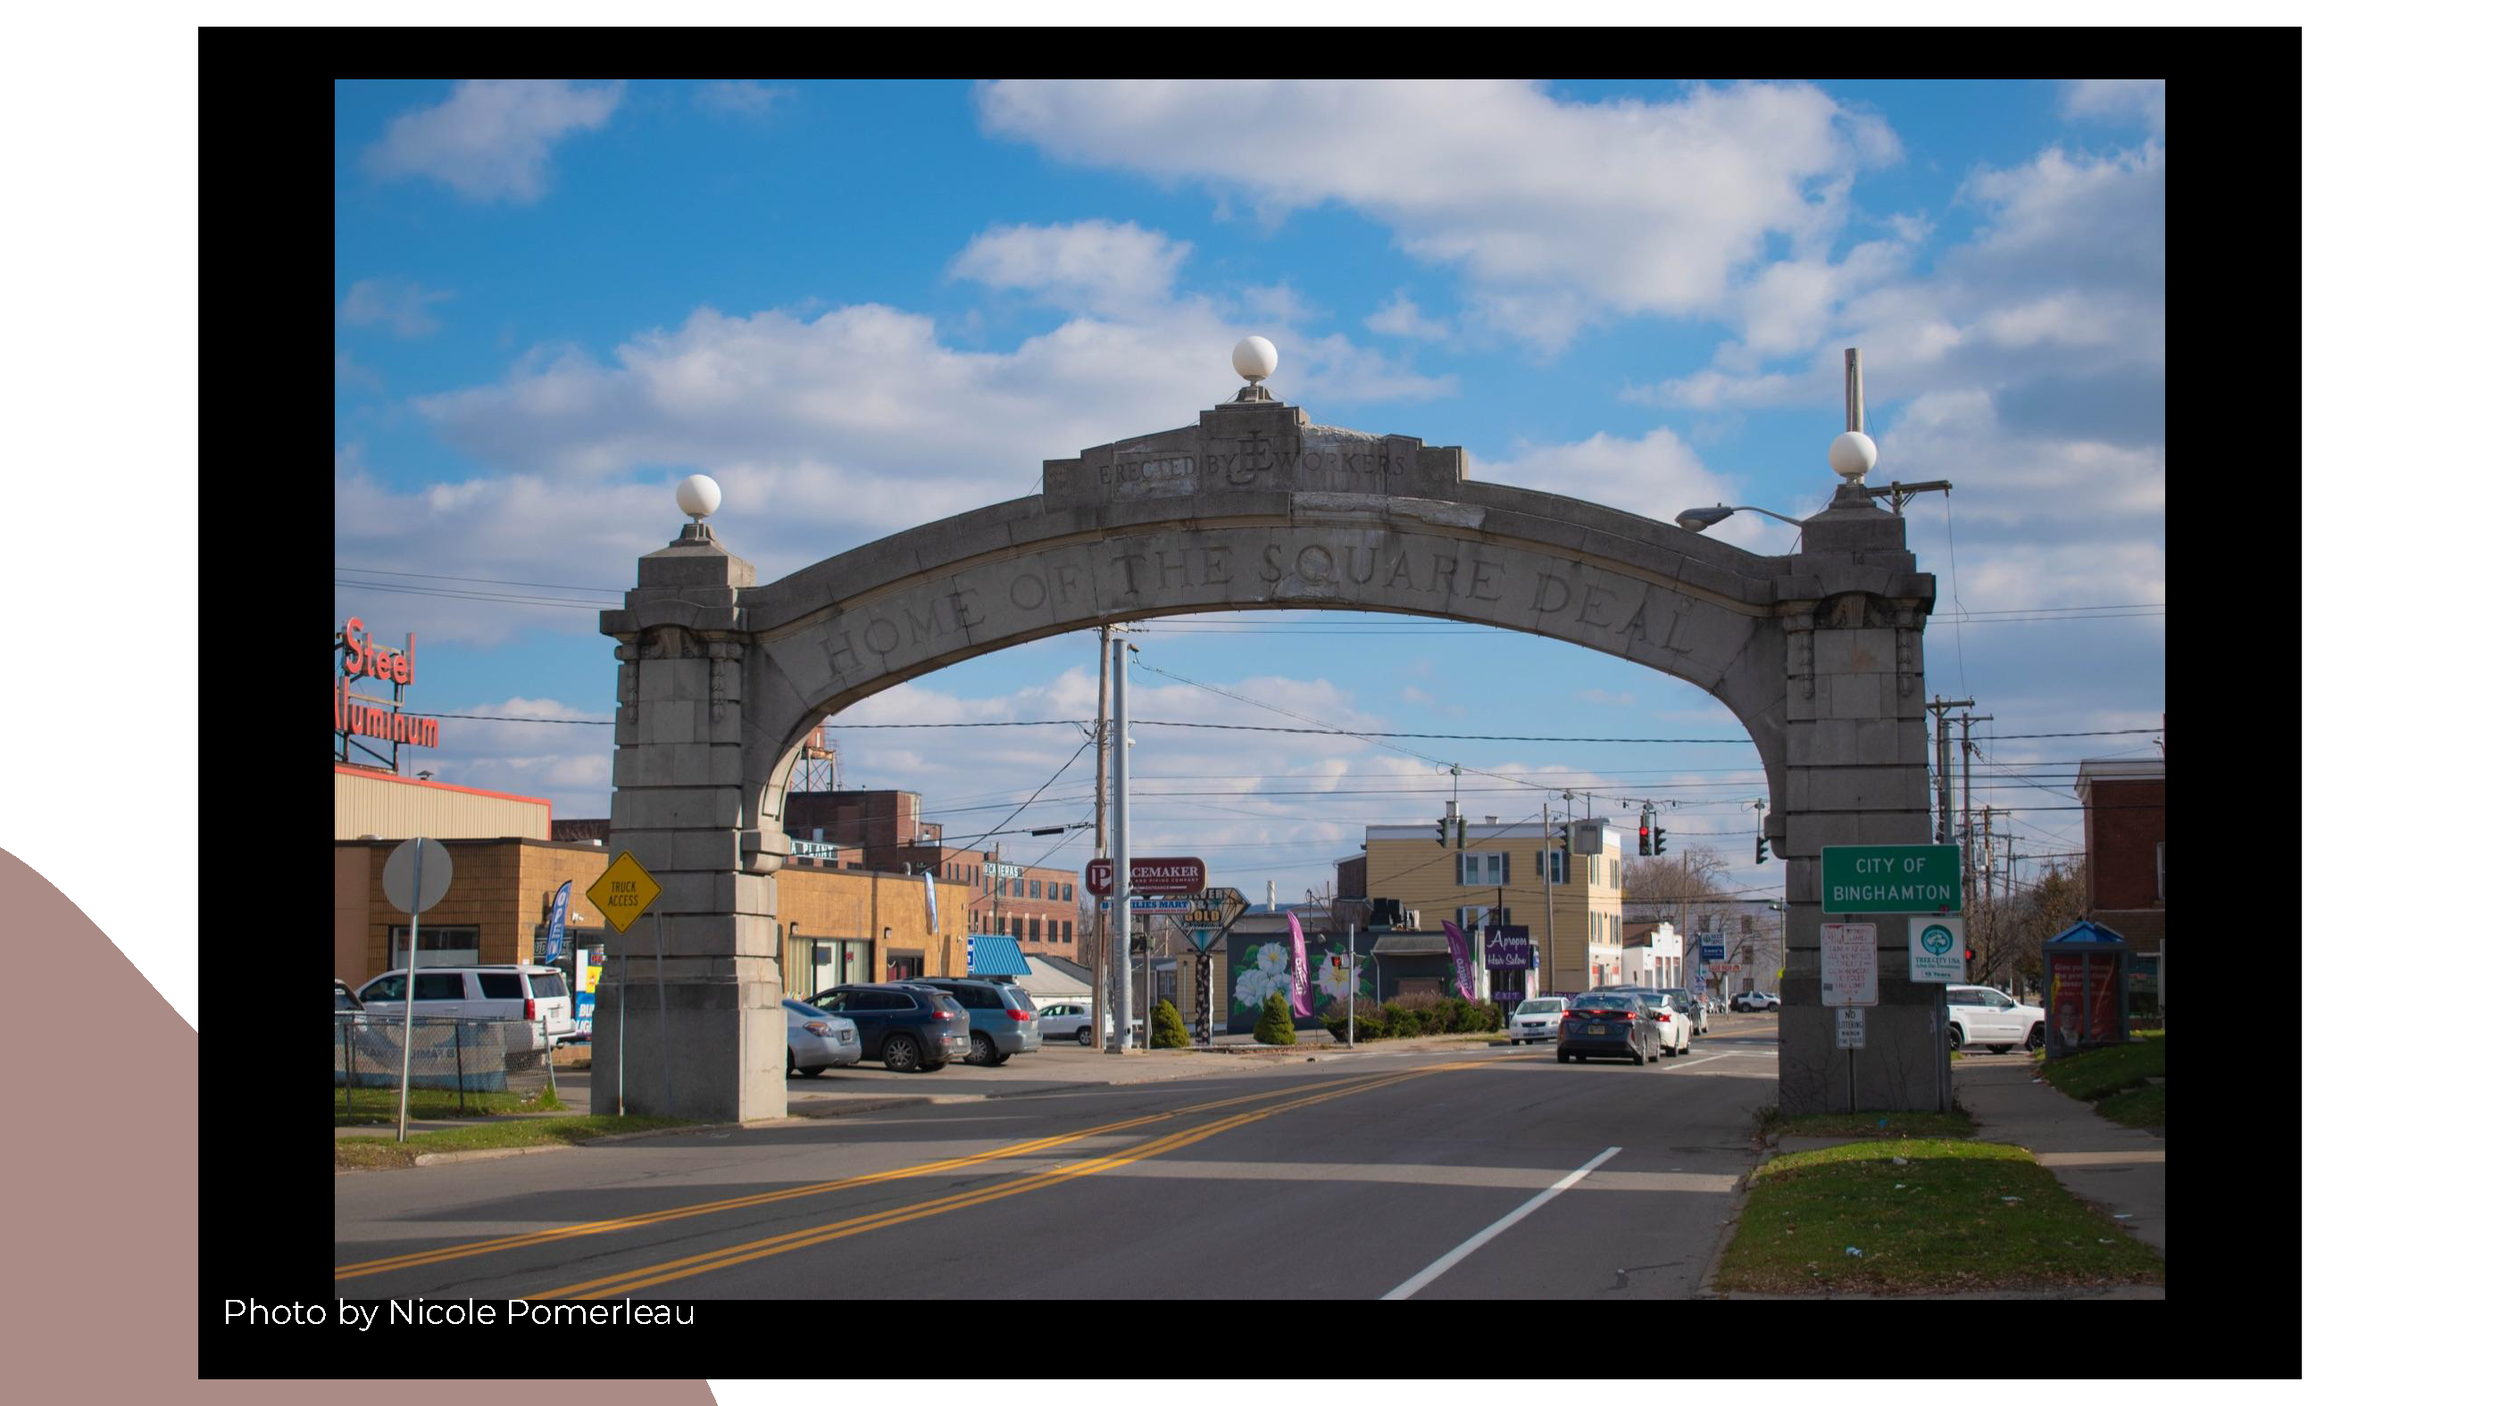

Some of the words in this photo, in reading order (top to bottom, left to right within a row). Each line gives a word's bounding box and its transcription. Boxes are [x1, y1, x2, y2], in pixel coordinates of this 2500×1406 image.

[1100, 455, 1195, 484] ERECTED
[1207, 452, 1237, 475] BY
[1272, 451, 1405, 476] WORKERS
[819, 587, 986, 678] HOME
[1009, 564, 1083, 611] OF
[1111, 545, 1235, 595] THE
[1258, 543, 1508, 600] SQUARE
[1528, 571, 1694, 655] DEAL
[345, 616, 416, 686] Steel
[803, 843, 834, 857] PLANT
[1130, 866, 1199, 877] CEMAKER
[1855, 857, 1895, 873] CITY
[1903, 857, 1927, 873] OF
[611, 881, 637, 893] TRUCK
[1833, 884, 1951, 900] BINGHAMTON
[608, 895, 639, 907] ACCESS
[1159, 901, 1188, 909] MART
[551, 891, 566, 954] OPEN
[1184, 910, 1220, 922] GOLD
[1487, 953, 1504, 966] Hair
[1506, 954, 1527, 966] Salon
[1495, 991, 1518, 1000] EXIT
[1845, 1011, 1856, 1019] NO
[577, 1019, 592, 1033] LIG
